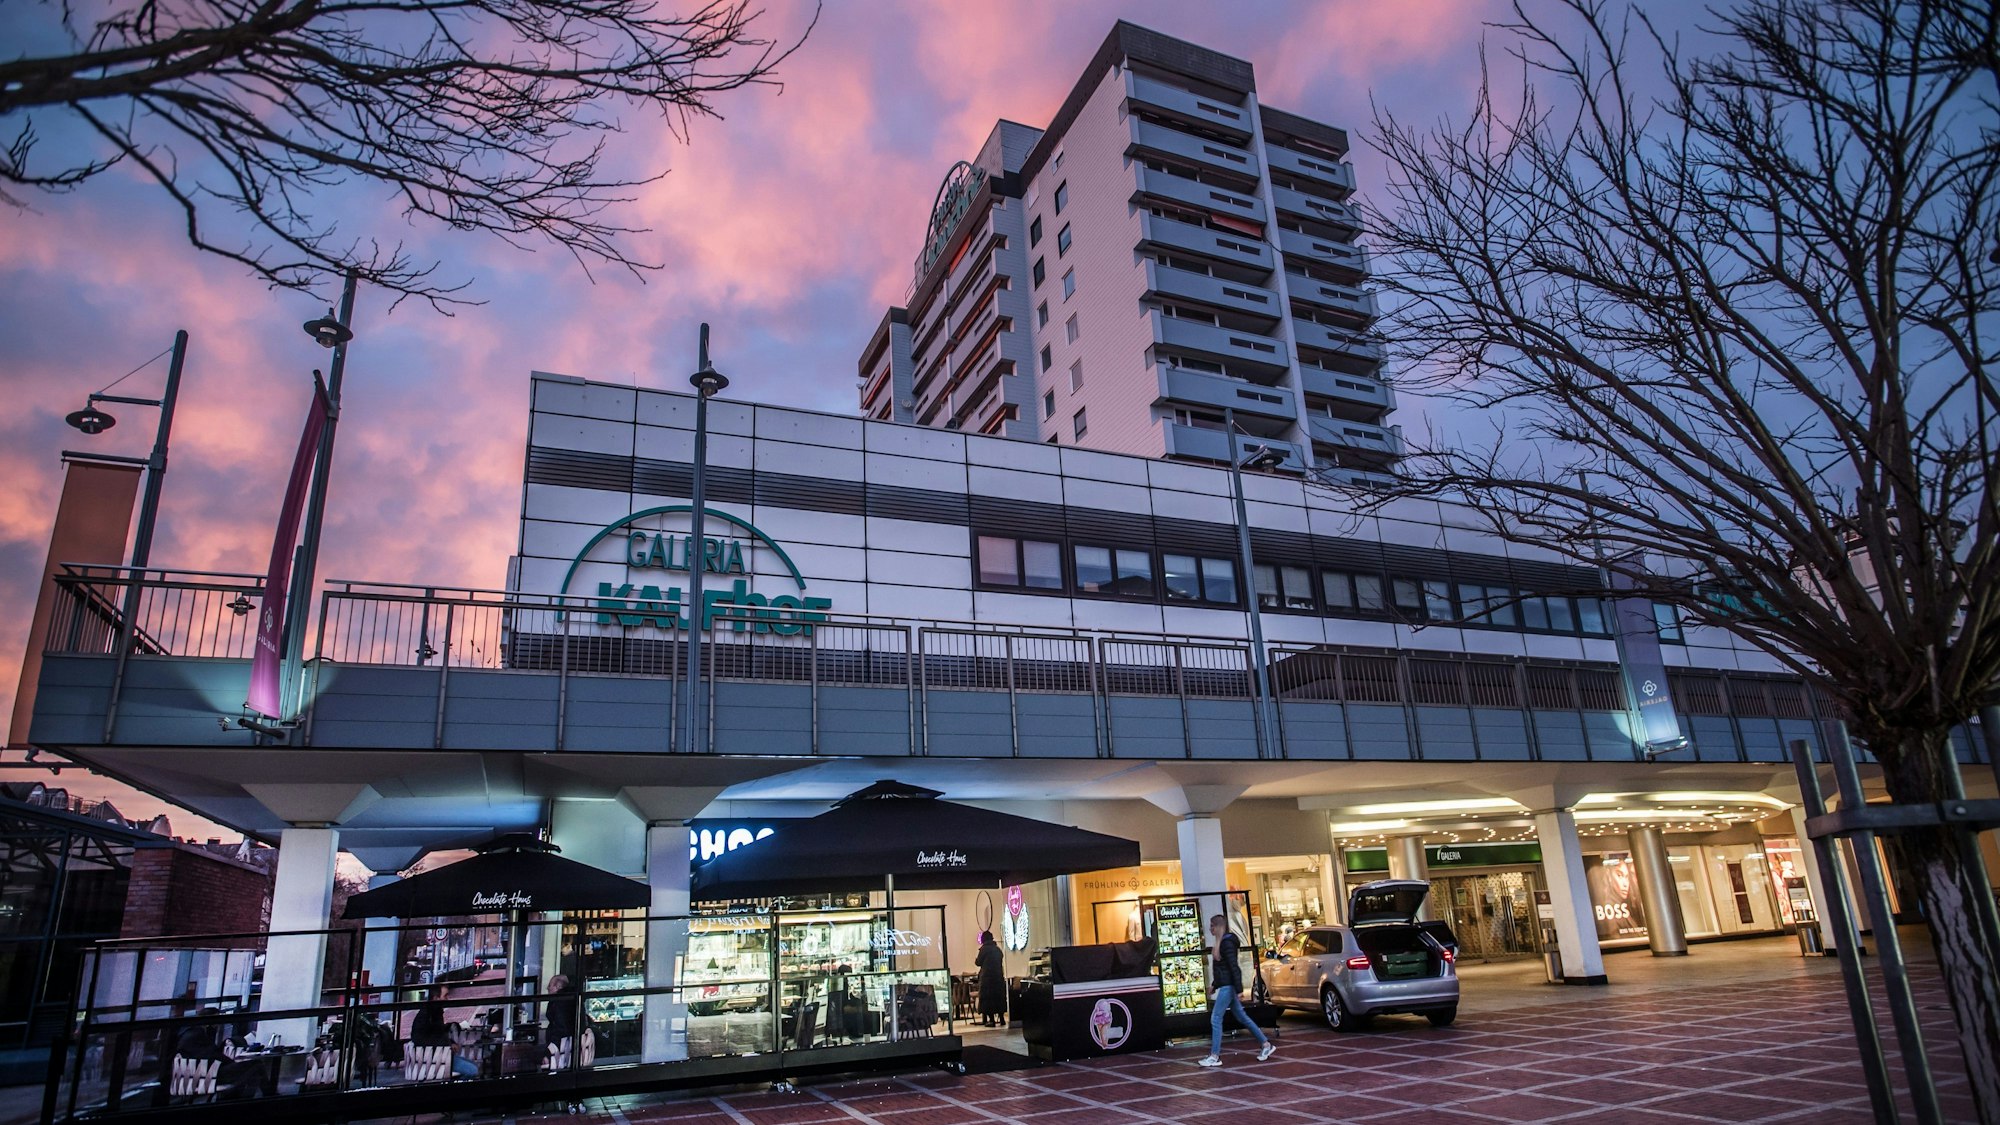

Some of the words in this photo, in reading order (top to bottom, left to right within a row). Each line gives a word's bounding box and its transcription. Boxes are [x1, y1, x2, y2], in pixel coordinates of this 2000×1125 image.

[627, 532, 746, 575] GALERIA
[917, 850, 946, 864] Chocolate
[946, 849, 967, 866] Haus
[1440, 851, 1462, 861] GALERIA
[1142, 878, 1180, 887] GALERIA
[472, 891, 508, 906] Chocolate
[508, 890, 532, 907] Haus
[1595, 903, 1631, 921] BOSS
